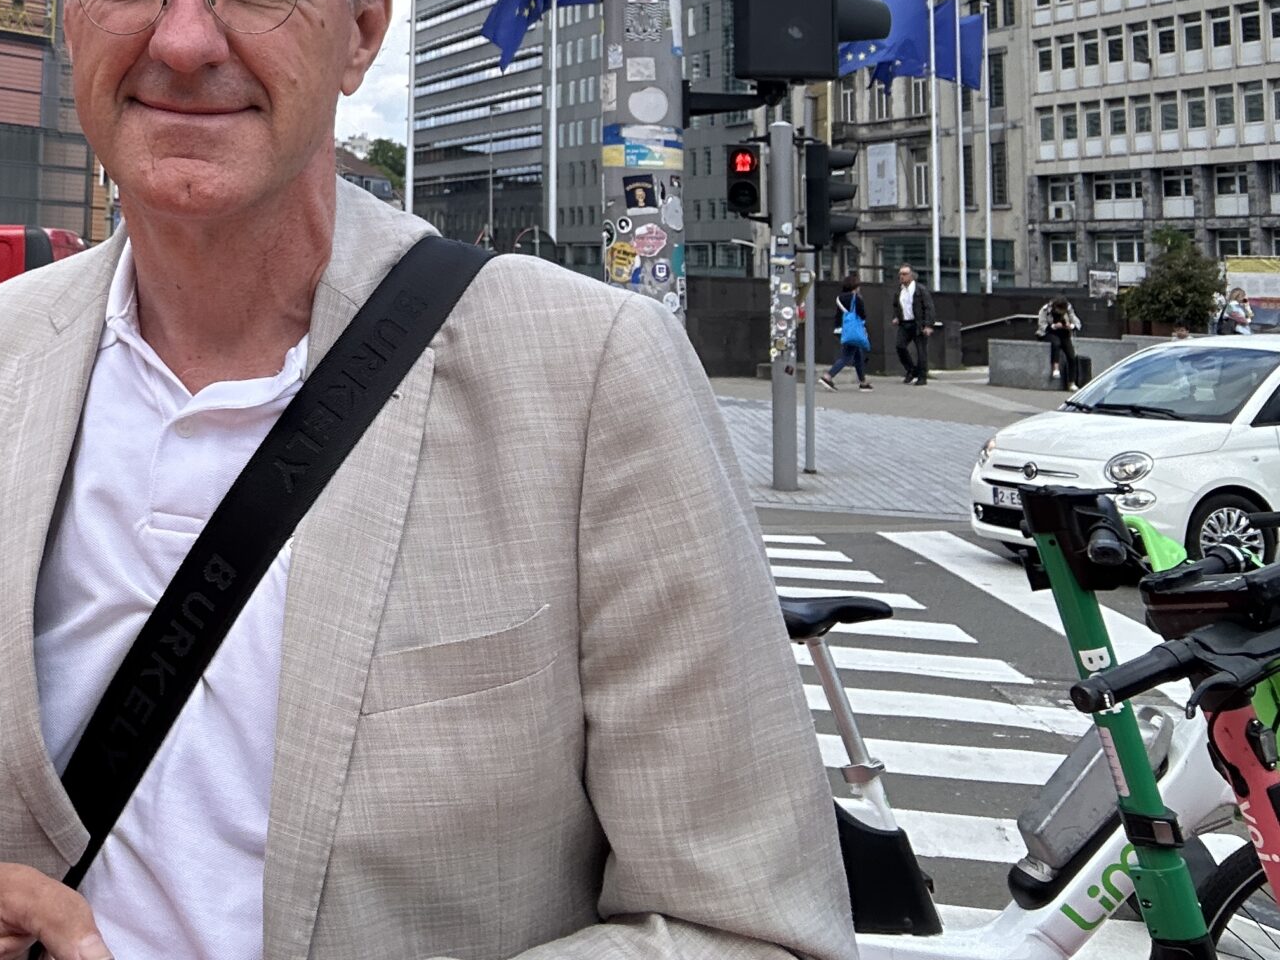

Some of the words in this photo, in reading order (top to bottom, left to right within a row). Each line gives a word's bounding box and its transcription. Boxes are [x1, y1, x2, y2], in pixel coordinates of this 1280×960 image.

[271, 288, 429, 495] BURKELY
[97, 551, 238, 775] BURKELY
[1060, 843, 1139, 931] Lim
